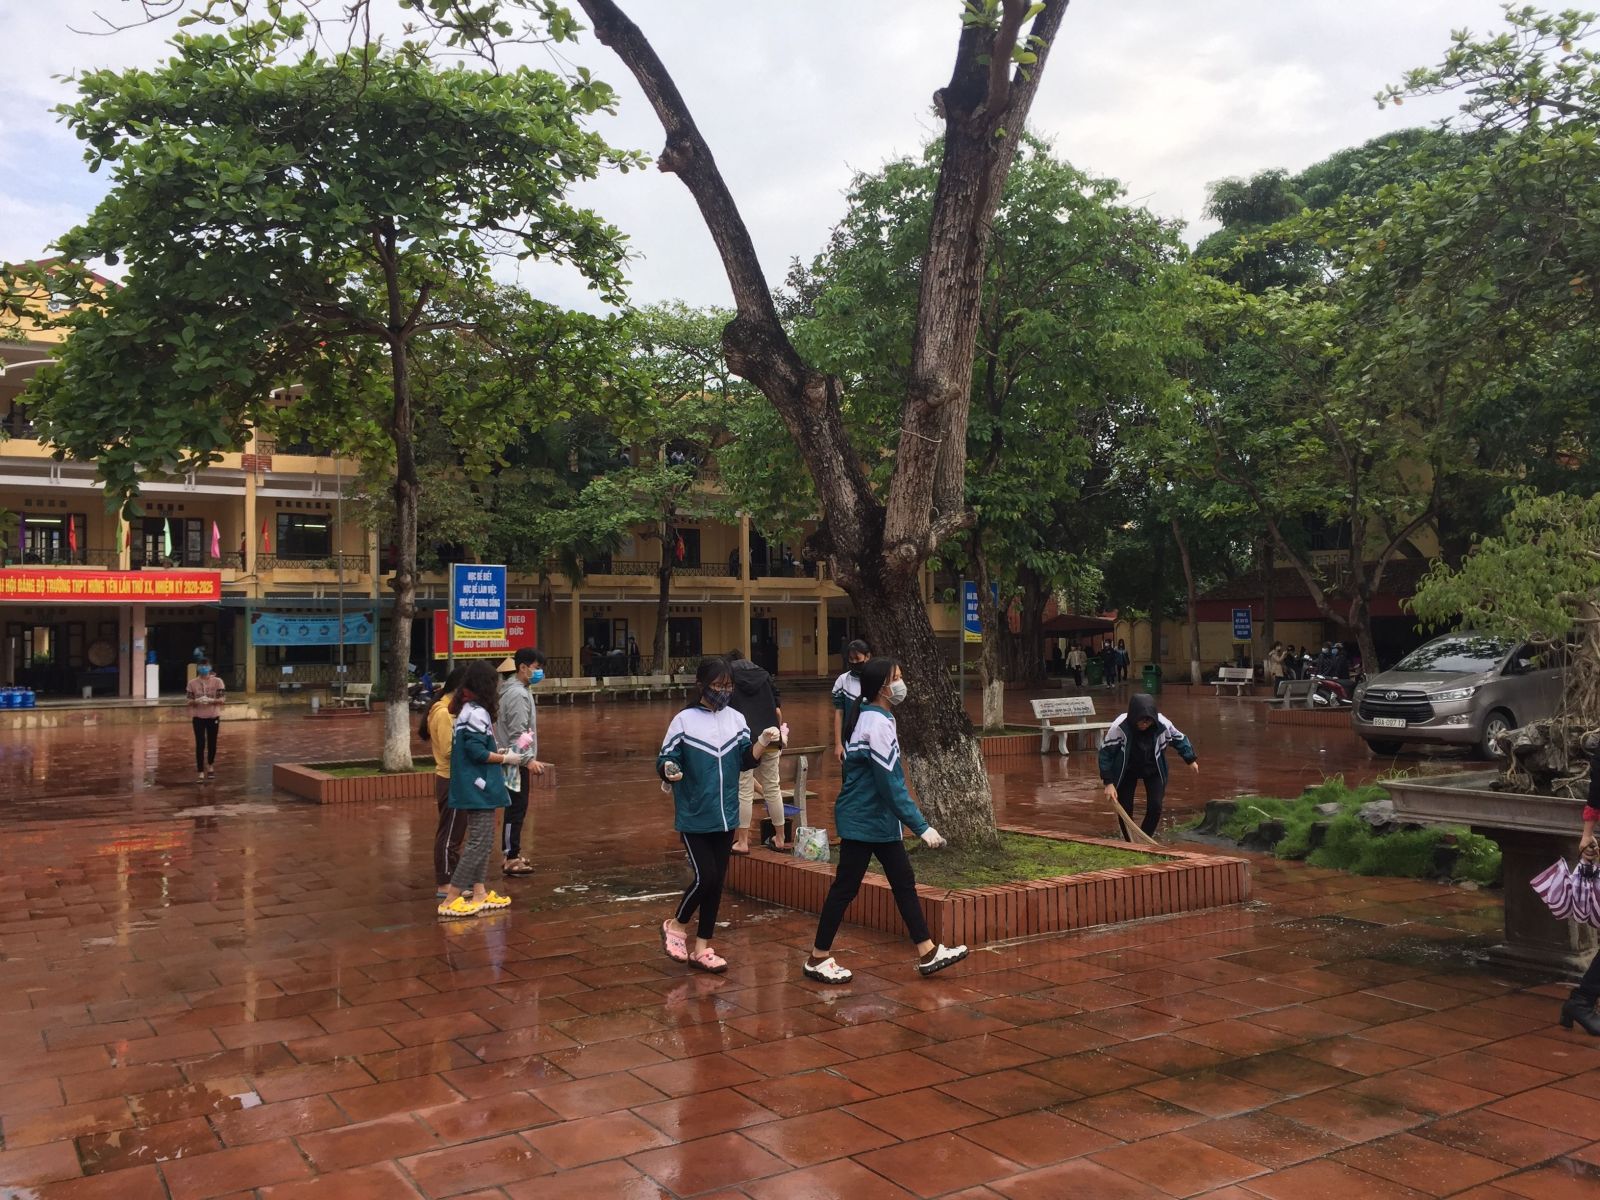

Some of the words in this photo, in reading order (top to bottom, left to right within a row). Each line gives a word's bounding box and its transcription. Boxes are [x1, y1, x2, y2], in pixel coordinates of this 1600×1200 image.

[468, 572, 476, 582] HỌC
[6, 576, 16, 596] HỘI
[18, 574, 35, 592] ĐẢNG
[36, 576, 45, 596] BỘ
[46, 576, 71, 593] TRƯỜNG
[72, 579, 86, 593] THPT
[88, 578, 105, 593] HƯNG
[106, 577, 118, 593] YÊN
[119, 576, 131, 593] LẦN
[155, 578, 174, 596] NHIỆM
[184, 581, 214, 594] 2020-2025
[463, 585, 471, 595] HỌC
[478, 584, 487, 593] LÀM
[459, 598, 468, 608] HỌC
[461, 611, 470, 621] HỌC
[477, 609, 485, 620] LÀM
[509, 626, 524, 635] ĐỨC
[490, 640, 509, 648] MINH
